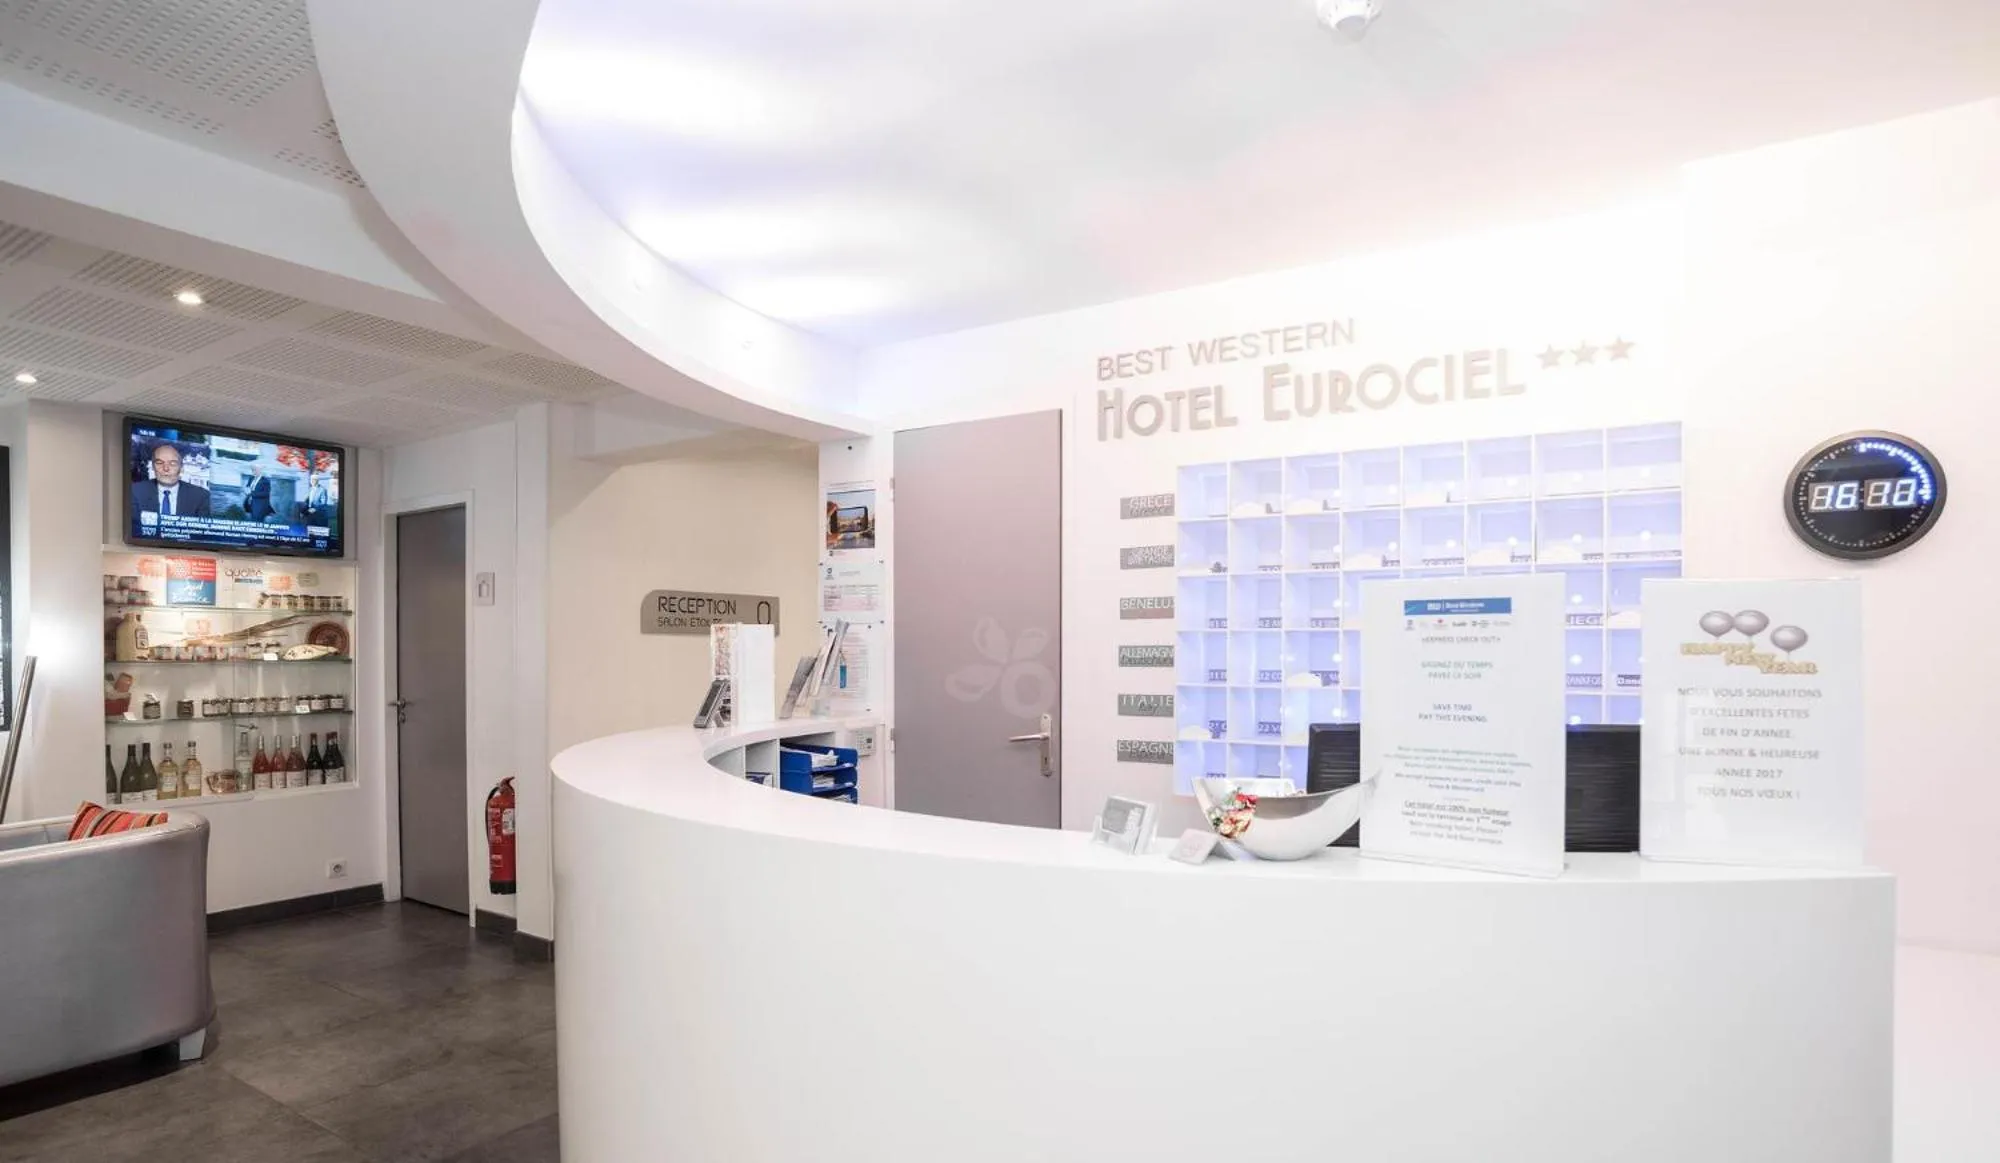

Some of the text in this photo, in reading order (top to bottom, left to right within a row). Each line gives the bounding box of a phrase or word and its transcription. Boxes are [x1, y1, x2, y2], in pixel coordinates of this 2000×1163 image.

[1097, 318, 1355, 381] BEST WESTERN
[1097, 348, 1526, 441] HOTEL EUROCIEL
[658, 595, 737, 615] RECEPTION
[658, 616, 687, 628] SALON
[1567, 615, 1604, 625] IEG
[1712, 687, 1743, 698] VOUS
[1746, 687, 1823, 699] SOUHAITONS
[1121, 695, 1174, 706] ITALIE
[1701, 727, 1717, 737] DE
[1719, 727, 1738, 737] FIN
[1748, 749, 1757, 758] &
[1760, 749, 1820, 760] HEUREUSE
[1755, 768, 1784, 778] 2017
[1729, 787, 1754, 798] NOS
